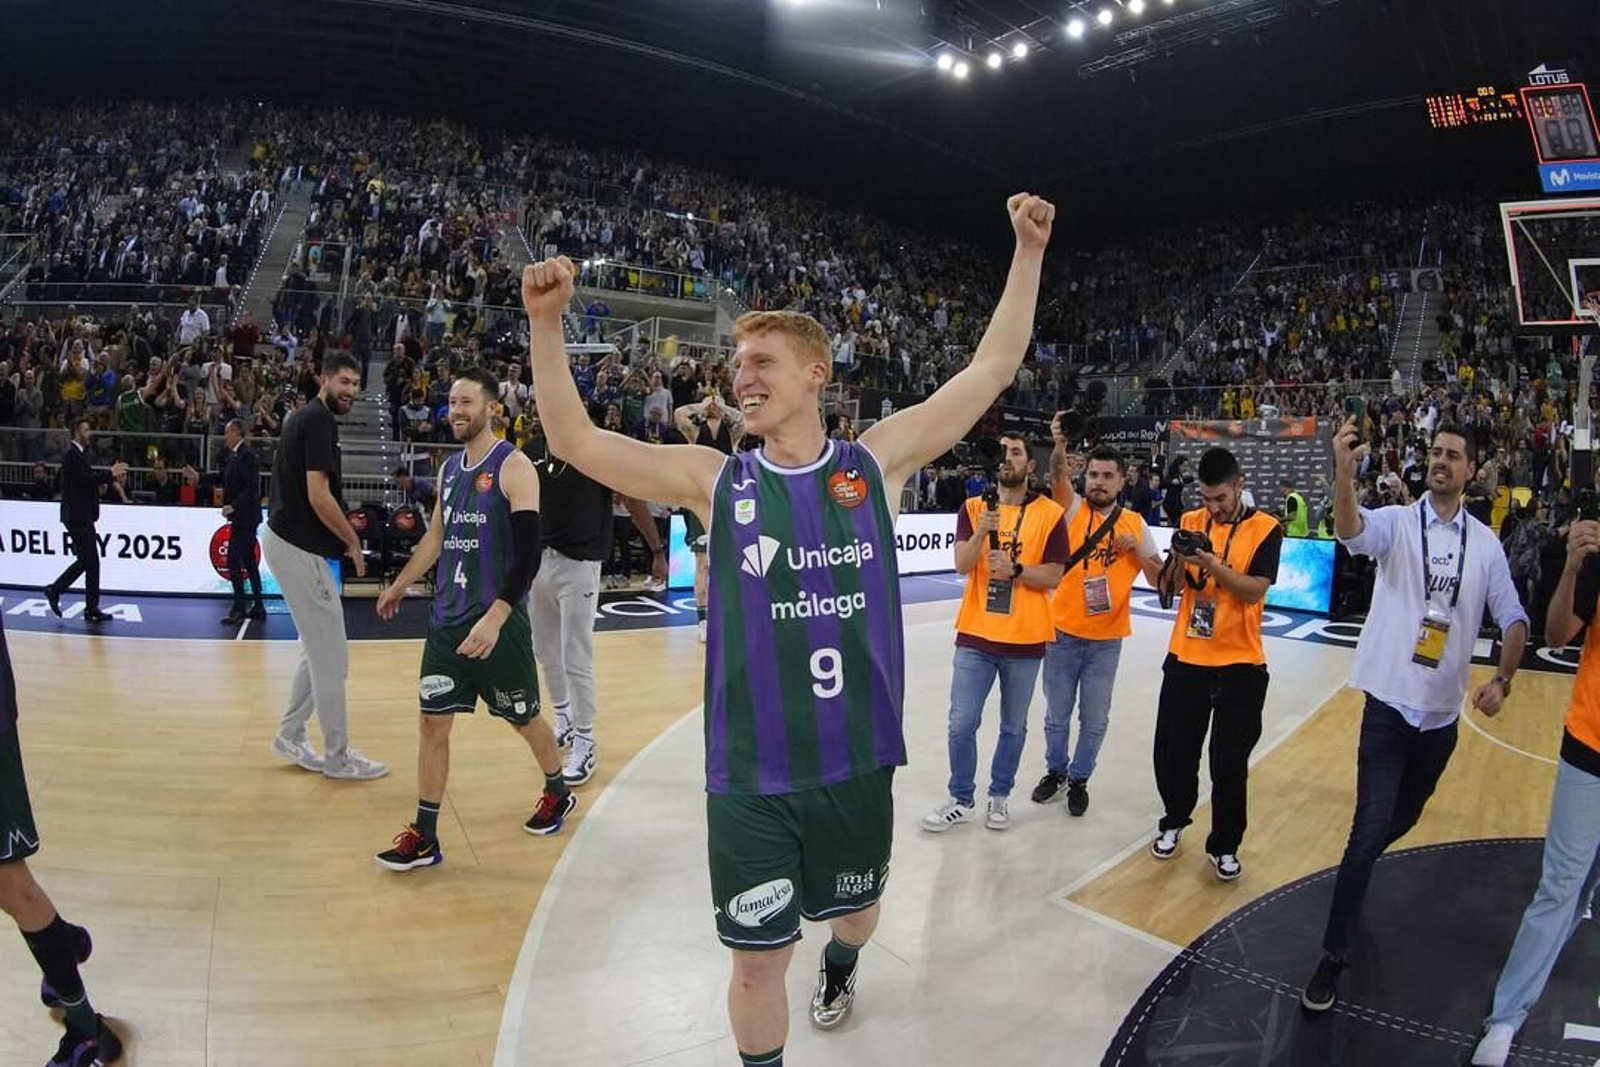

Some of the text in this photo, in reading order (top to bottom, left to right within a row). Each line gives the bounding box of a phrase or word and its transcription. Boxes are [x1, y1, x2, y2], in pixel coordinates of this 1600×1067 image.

[1528, 73, 1570, 86] LOTUS
[11, 528, 56, 555] DEL
[62, 531, 112, 558] RY
[117, 533, 183, 560] 2025
[786, 537, 874, 571] Unicaja
[453, 560, 468, 589] 4
[0, 597, 143, 622] RIA
[771, 590, 866, 620] málaga
[809, 647, 844, 699] 9
